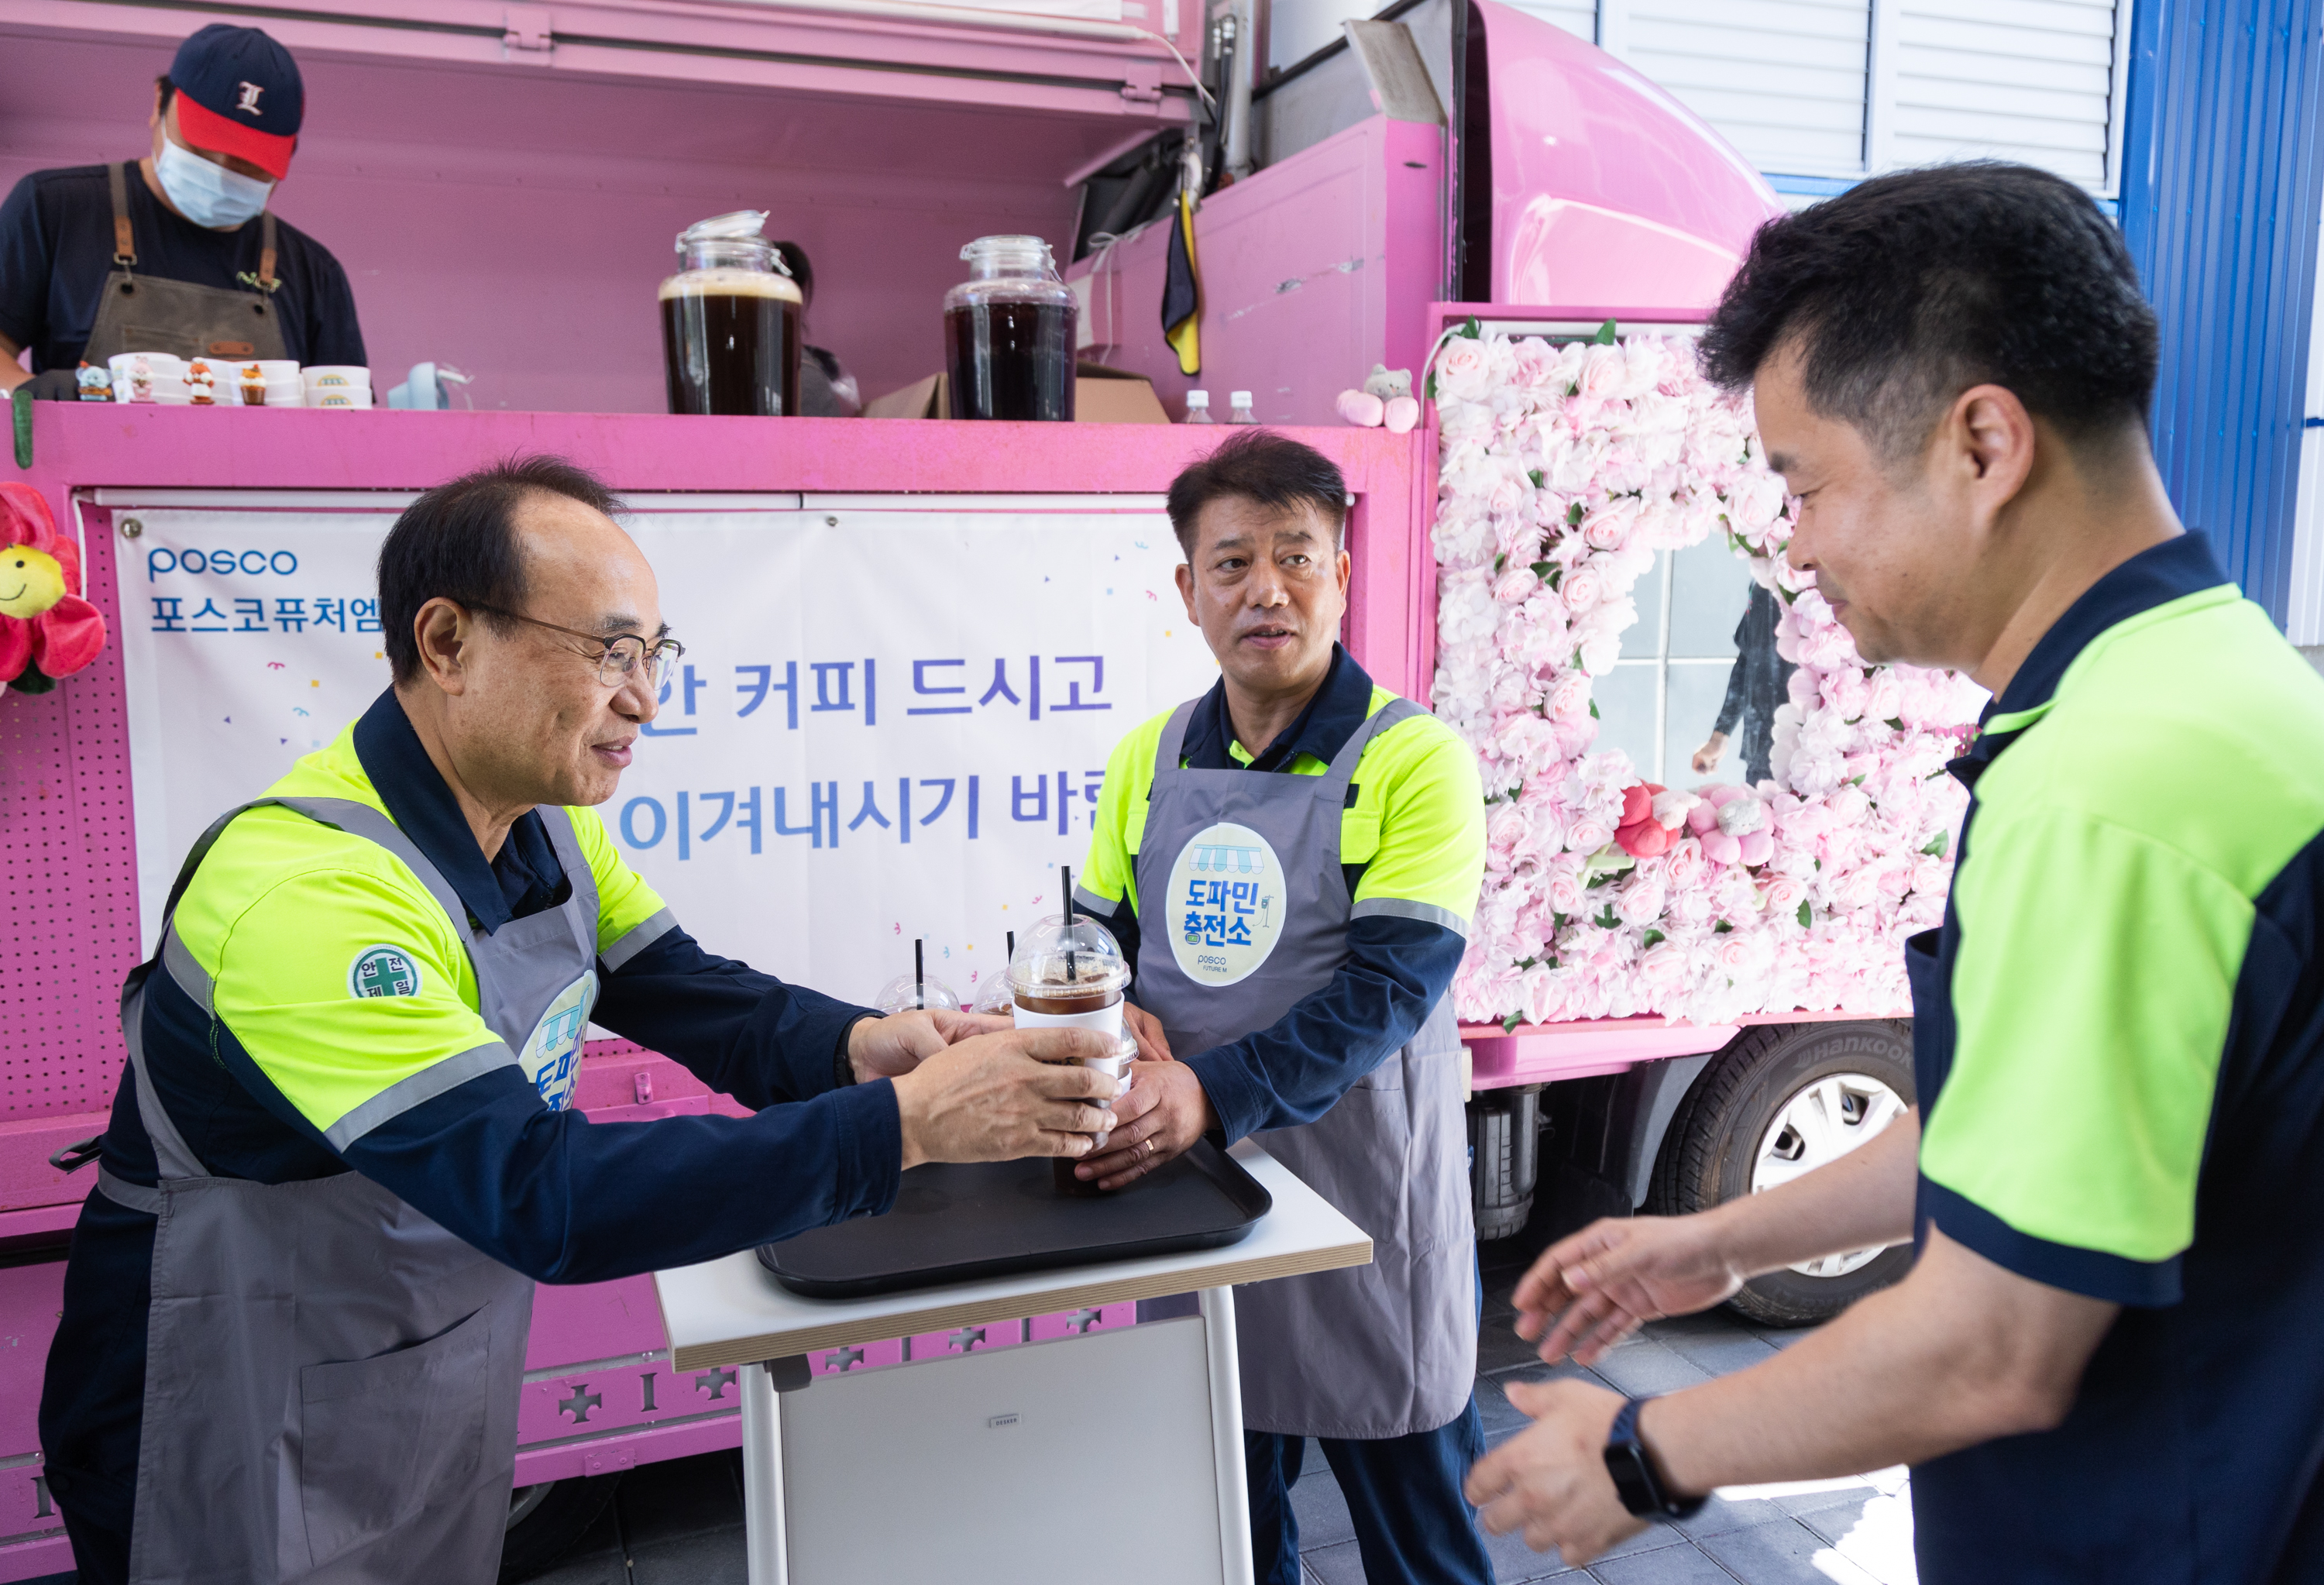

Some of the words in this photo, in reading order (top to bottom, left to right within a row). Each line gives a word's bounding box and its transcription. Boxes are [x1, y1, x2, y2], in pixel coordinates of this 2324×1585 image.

[148, 548, 297, 583] posco
[735, 658, 875, 730] 커피
[906, 655, 1112, 721] 드시고
[619, 774, 979, 861] 이겨내시기
[1185, 879, 1259, 915] 도파민
[1184, 910, 1252, 947] 충전소
[1198, 954, 1226, 965] posco
[995, 1418, 1017, 1426] DESKER
